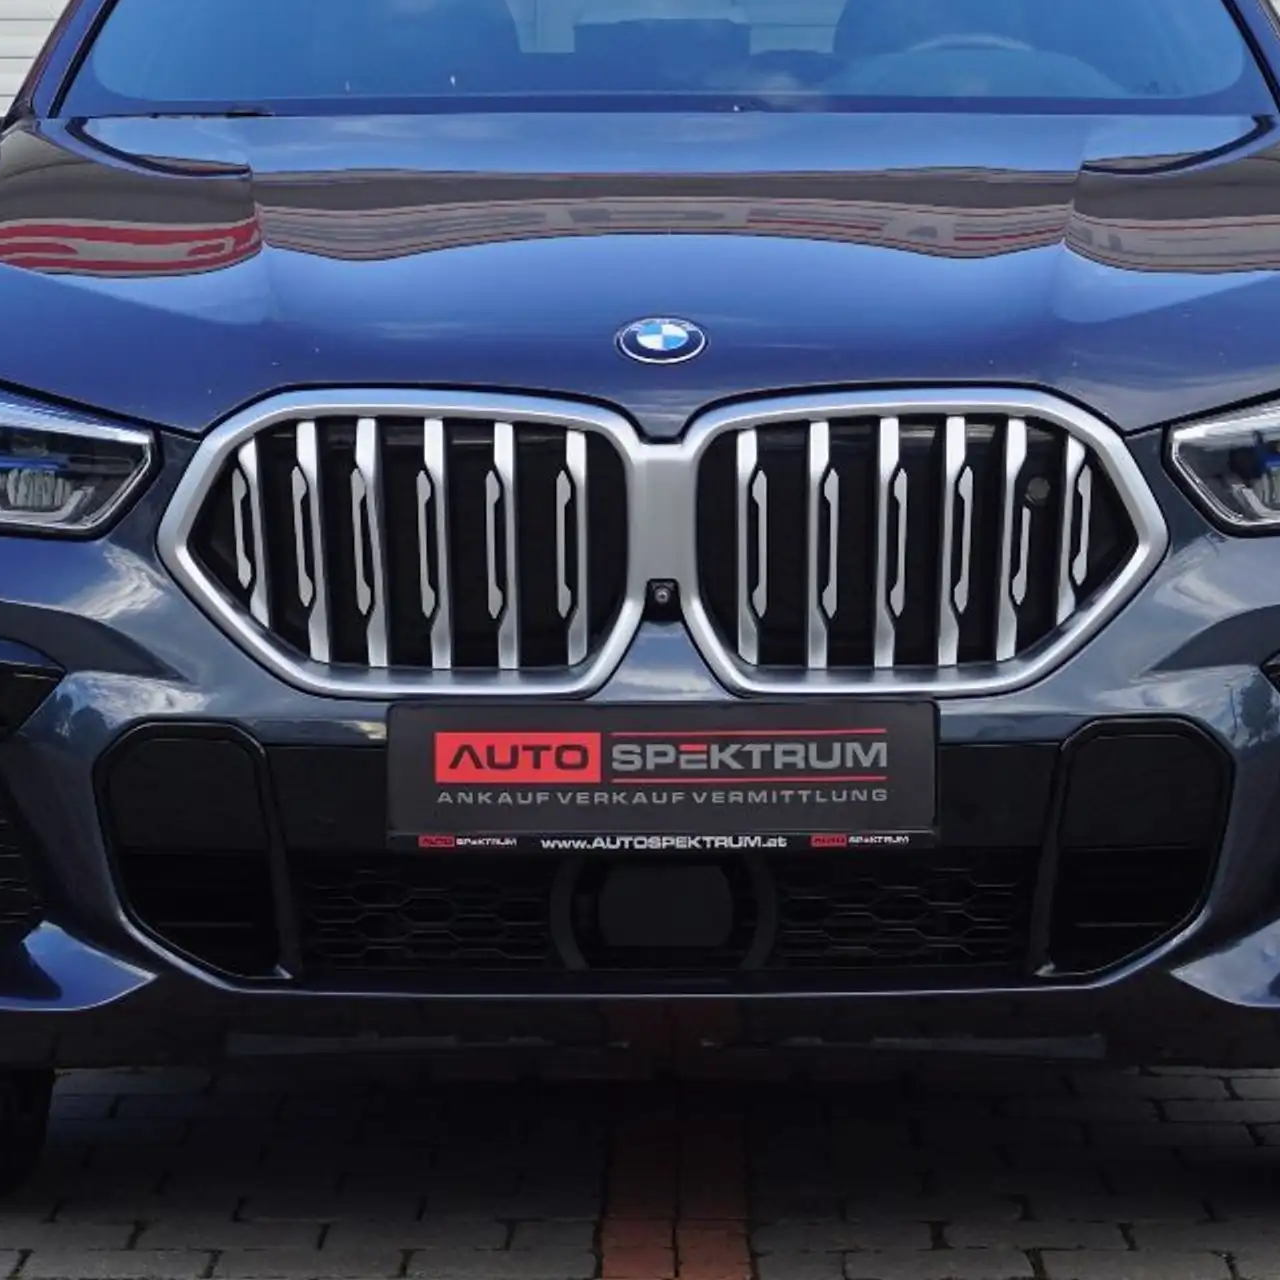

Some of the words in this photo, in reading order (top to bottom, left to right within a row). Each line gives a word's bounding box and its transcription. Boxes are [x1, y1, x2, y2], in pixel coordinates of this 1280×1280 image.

[449, 743, 590, 771] AUTO
[611, 742, 888, 772] SPEKTRUM
[437, 790, 550, 805] ANKAUF
[556, 790, 685, 805] VERKAUF
[691, 788, 888, 804] VERMITTLUNG
[540, 836, 787, 849] www.AUTOSPEKTRUM.at
